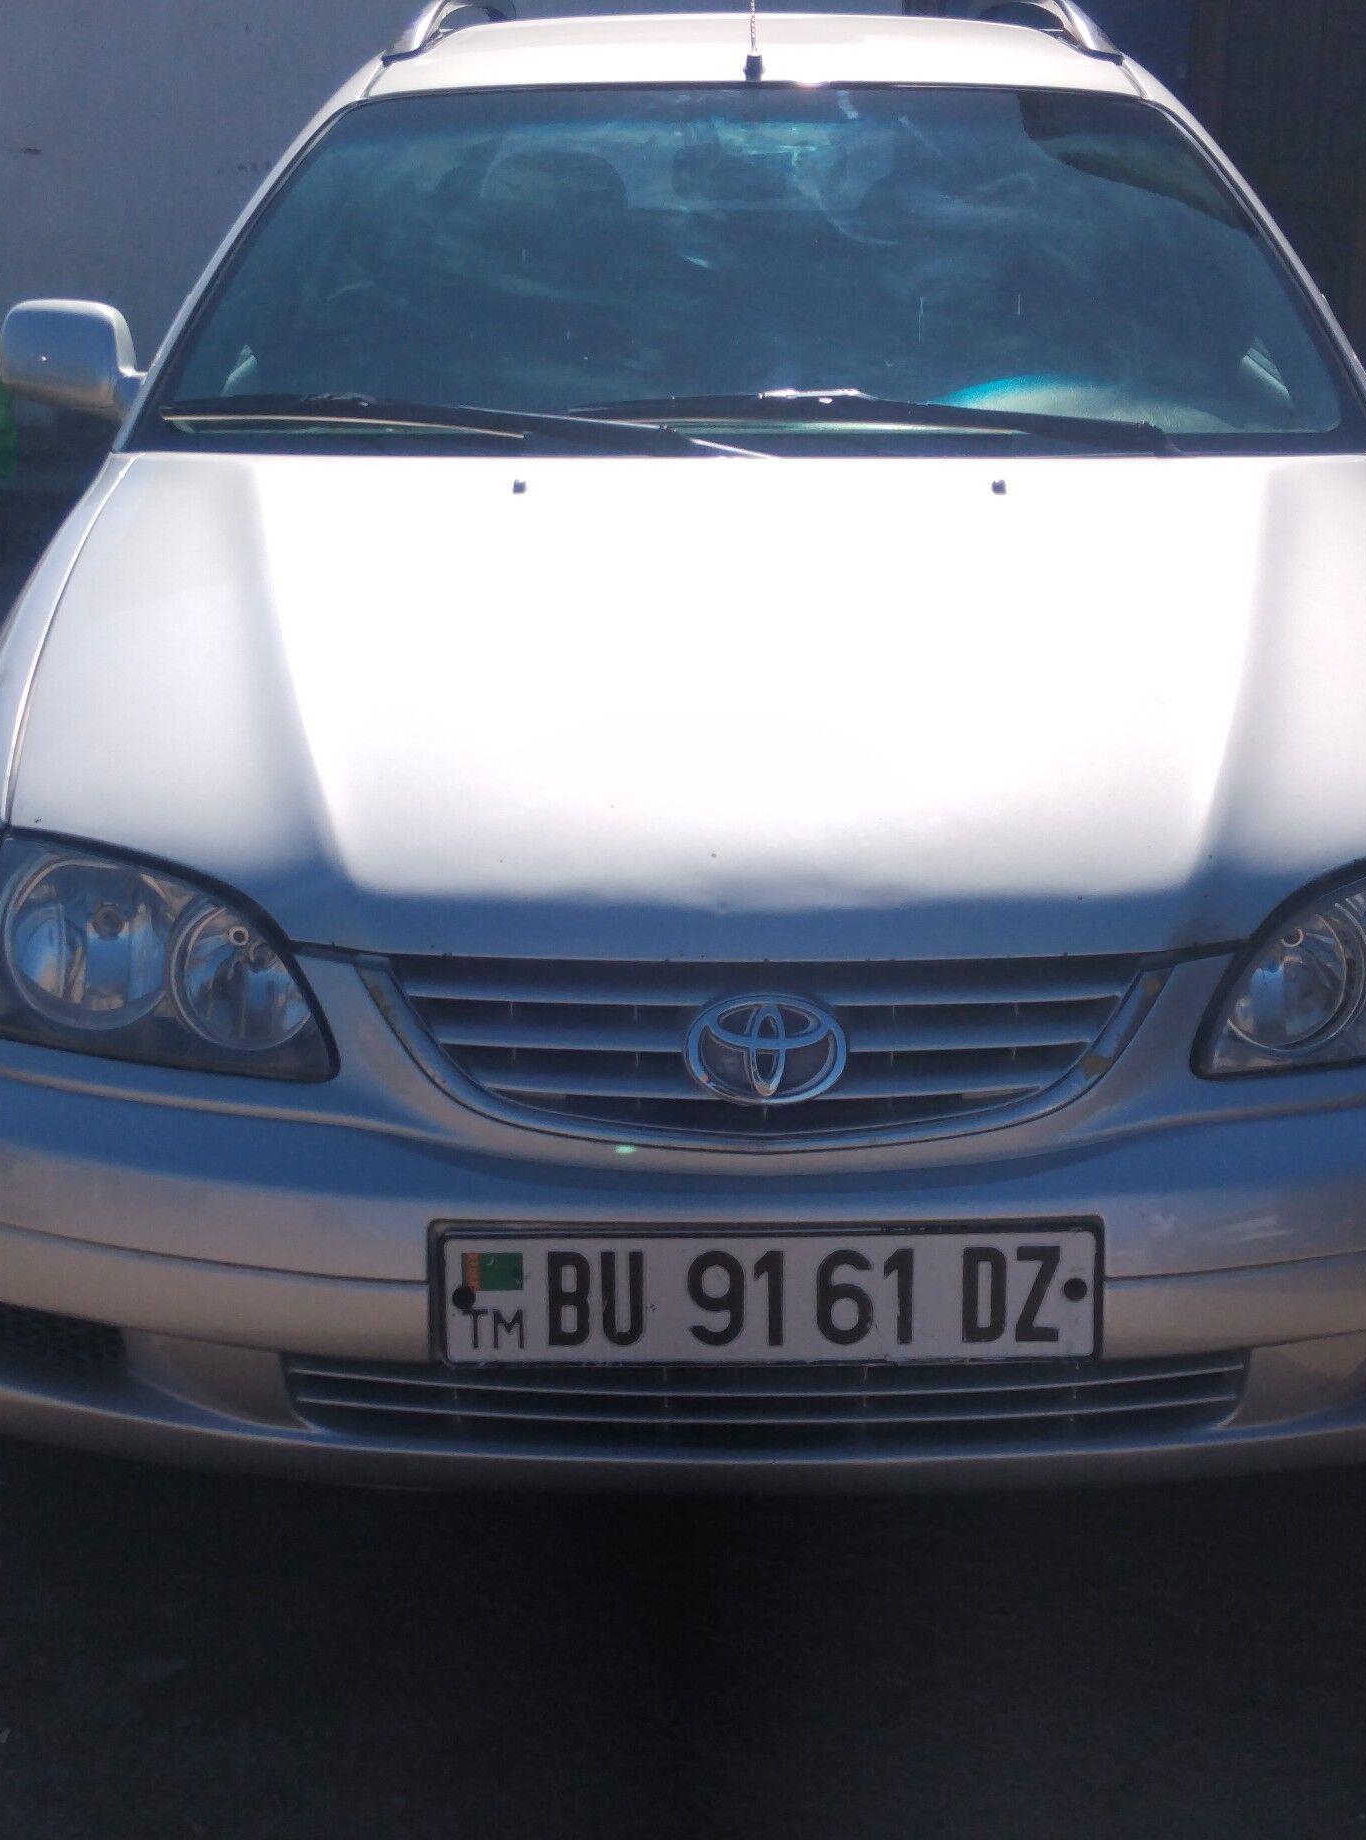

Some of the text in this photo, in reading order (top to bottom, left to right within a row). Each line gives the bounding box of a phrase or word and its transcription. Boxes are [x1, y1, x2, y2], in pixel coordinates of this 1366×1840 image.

[462, 1308, 524, 1349] TM
[547, 1251, 644, 1346] BU
[962, 1245, 1061, 1343] DZ
